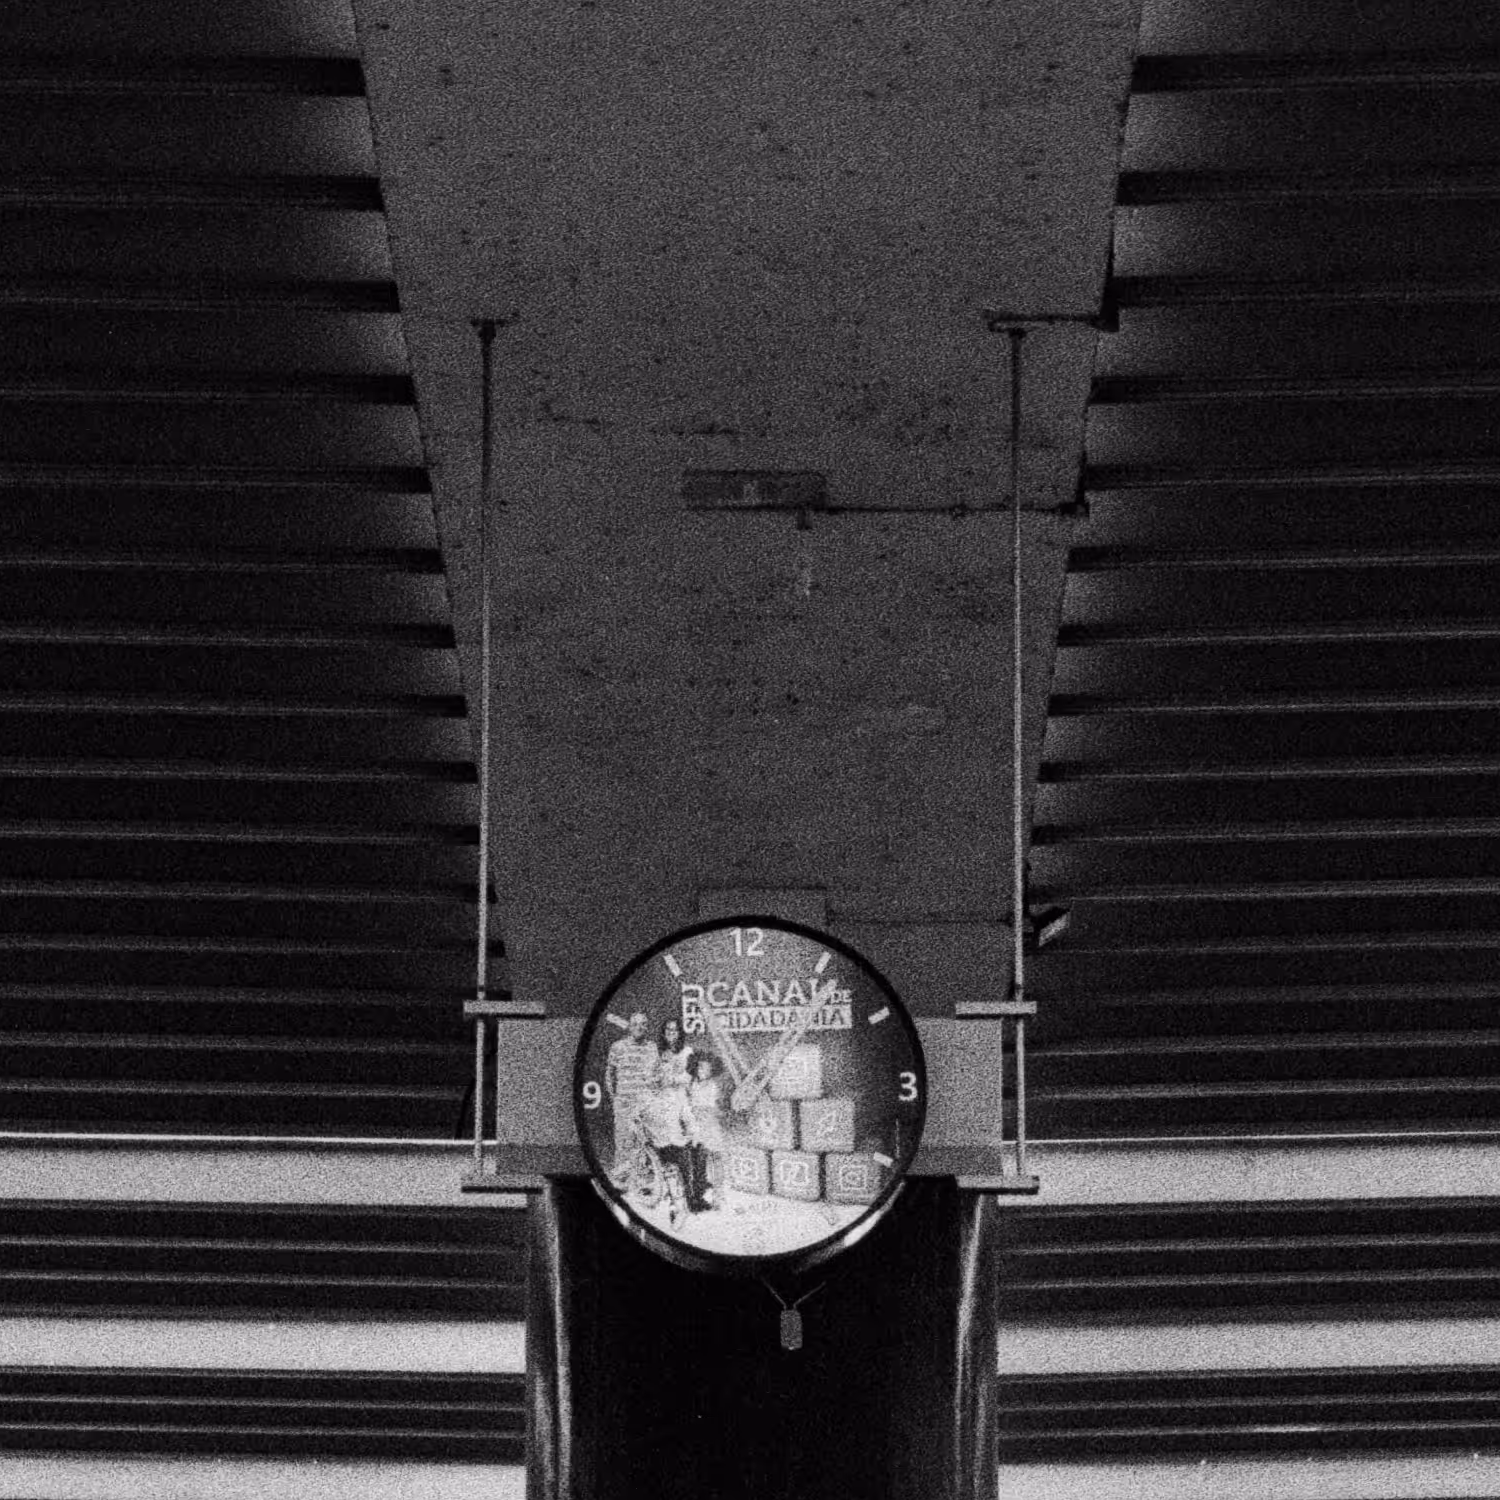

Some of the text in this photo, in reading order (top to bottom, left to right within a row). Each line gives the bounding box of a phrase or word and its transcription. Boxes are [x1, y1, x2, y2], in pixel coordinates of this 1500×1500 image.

[730, 927, 765, 956] 12
[582, 1081, 602, 1109] 9
[898, 1071, 918, 1101] 3
